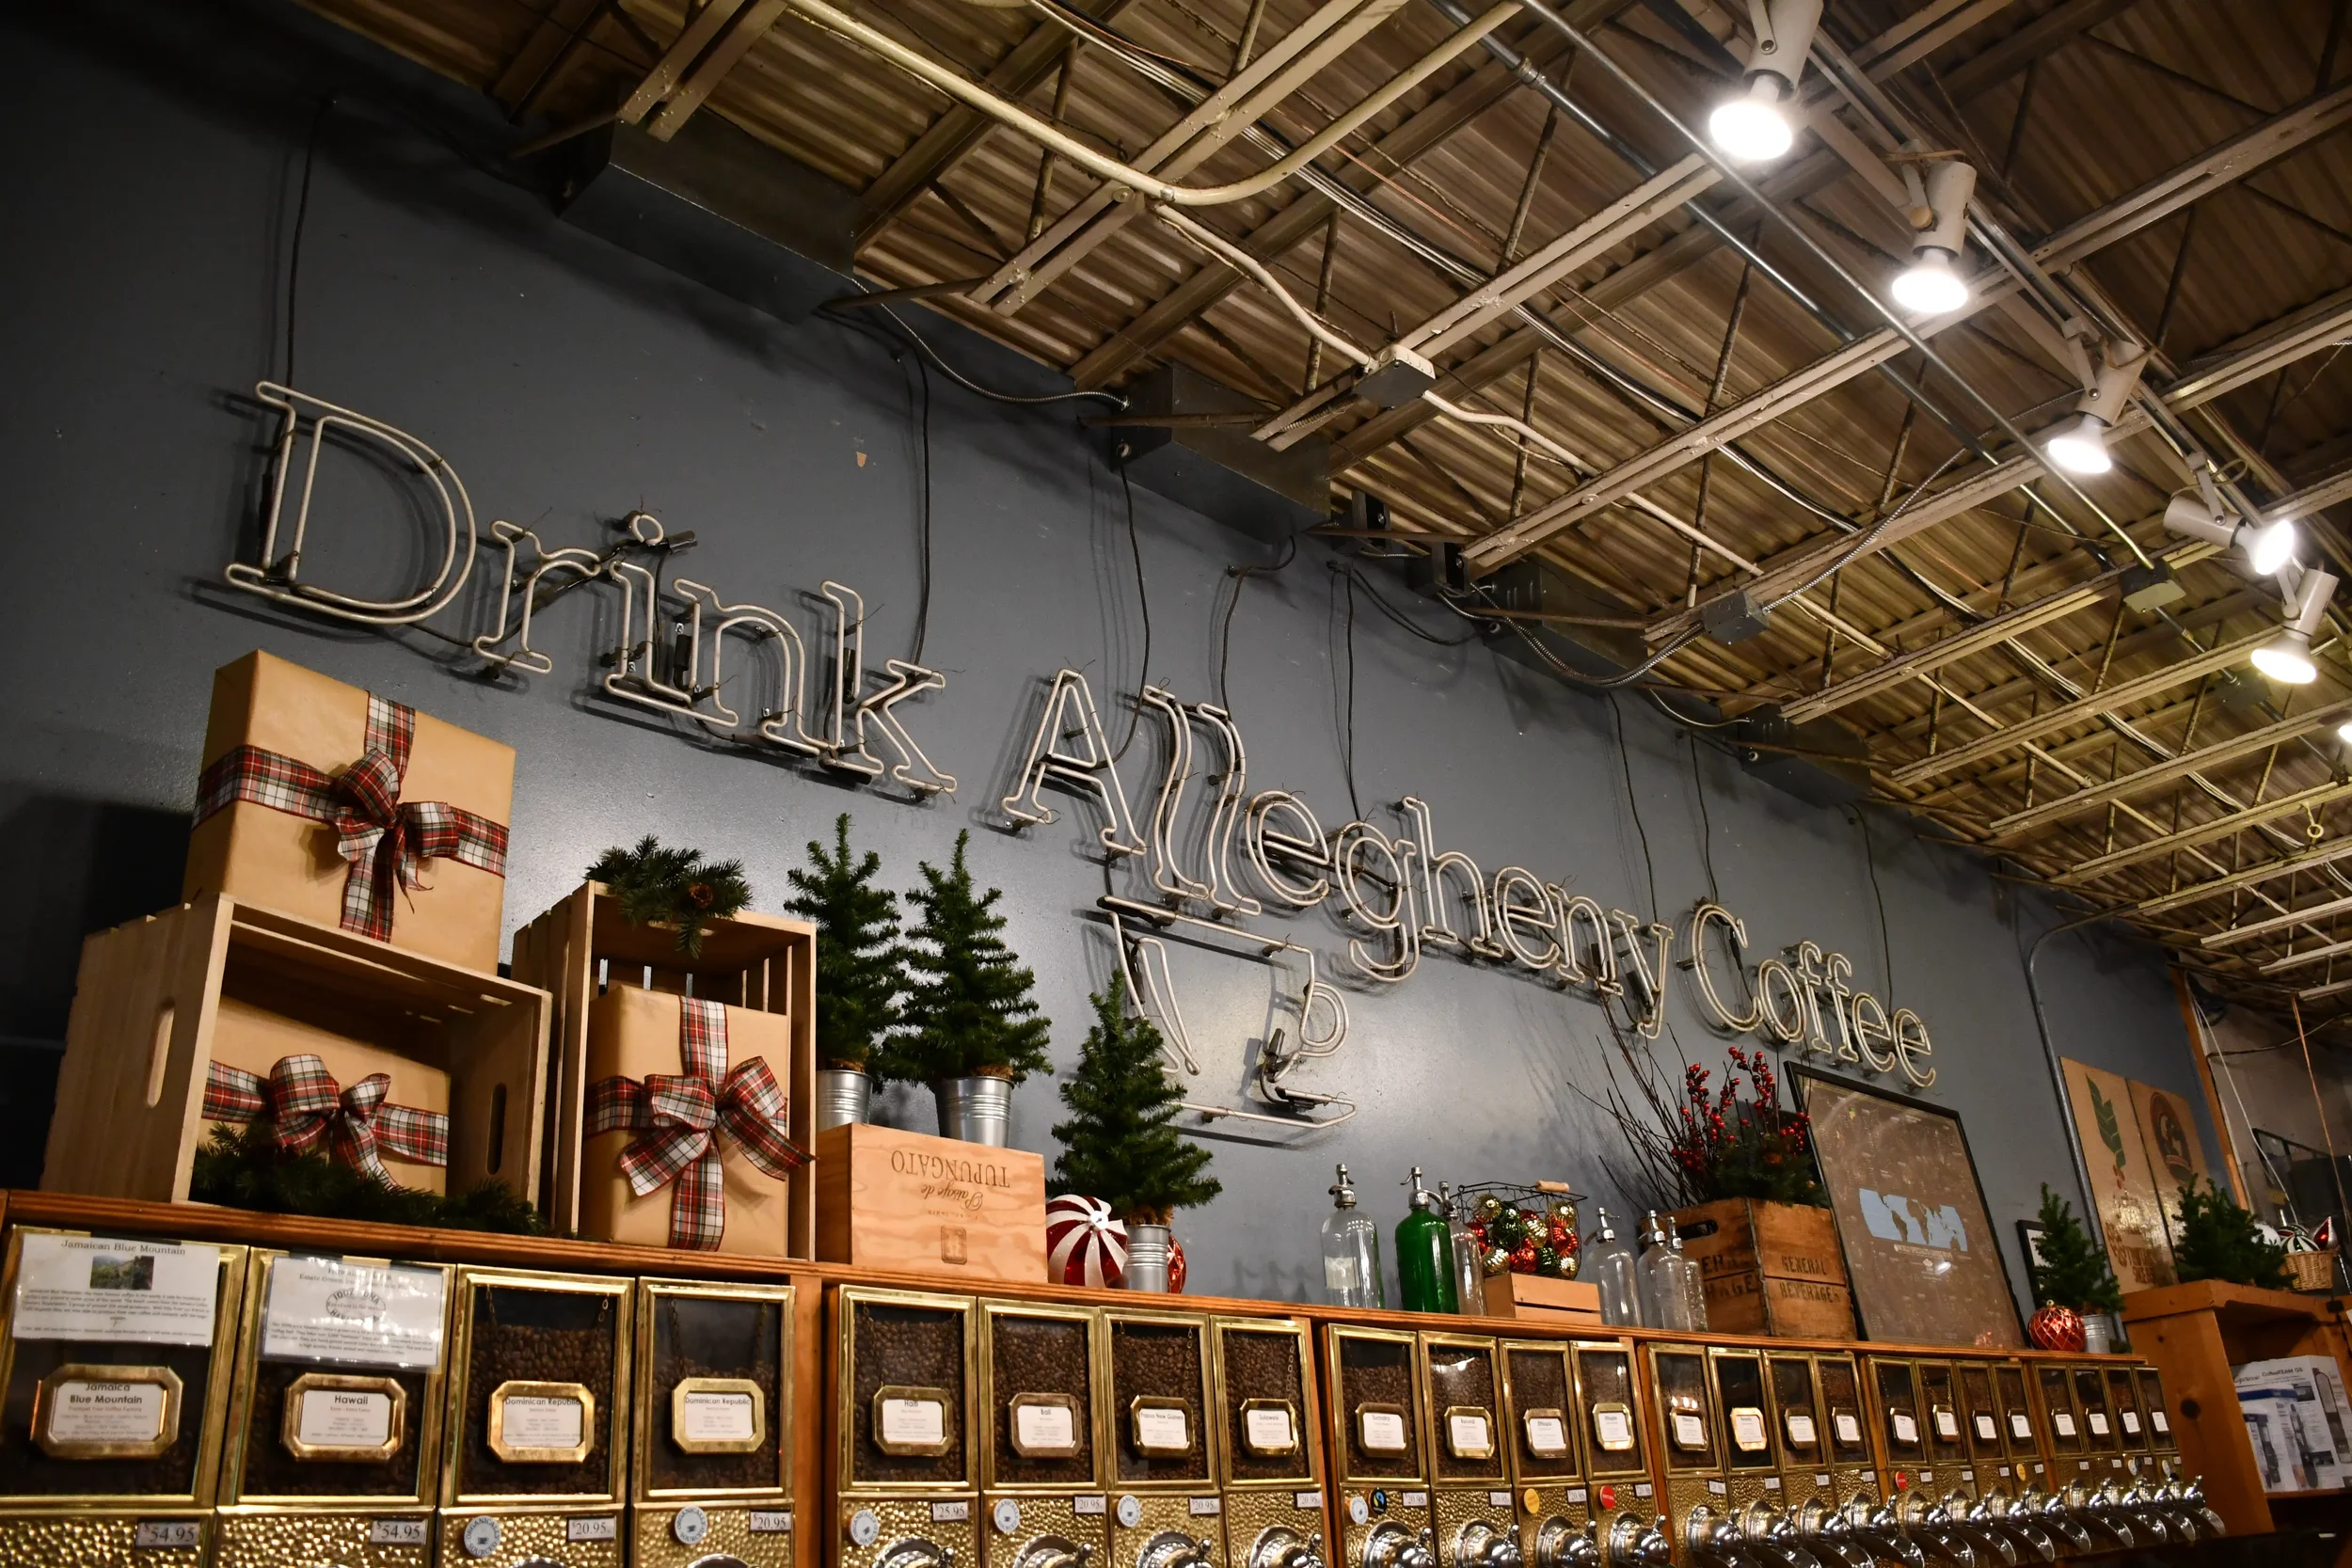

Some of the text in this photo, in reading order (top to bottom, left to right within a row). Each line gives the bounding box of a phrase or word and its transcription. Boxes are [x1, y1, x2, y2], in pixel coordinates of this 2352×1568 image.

[225, 380, 958, 793] Drink
[1000, 668, 1936, 1088] Allegheny Coffee
[891, 1149, 1010, 1189] TUPUNGATO
[920, 1180, 984, 1212] Paisaje de
[61, 1239, 186, 1256] Jamaican Blue Mountain
[1781, 1255, 1828, 1276] GENERAL
[85, 1383, 131, 1393] Jamaica
[70, 1394, 143, 1405] Blue Mountain
[334, 1394, 369, 1405] Hawaii
[505, 1397, 581, 1407] Dominican Republic
[723, 1398, 751, 1406] Republic
[676, 1508, 707, 1529] ORGANICALLY
[934, 1503, 965, 1518] $25.95
[465, 1517, 501, 1540] ORGANICALLY
[571, 1521, 607, 1535] $20.95
[754, 1513, 787, 1530] $20.95
[144, 1522, 196, 1544] $54.95
[376, 1520, 421, 1541] $54.95
[469, 1541, 498, 1556] SOURCED
